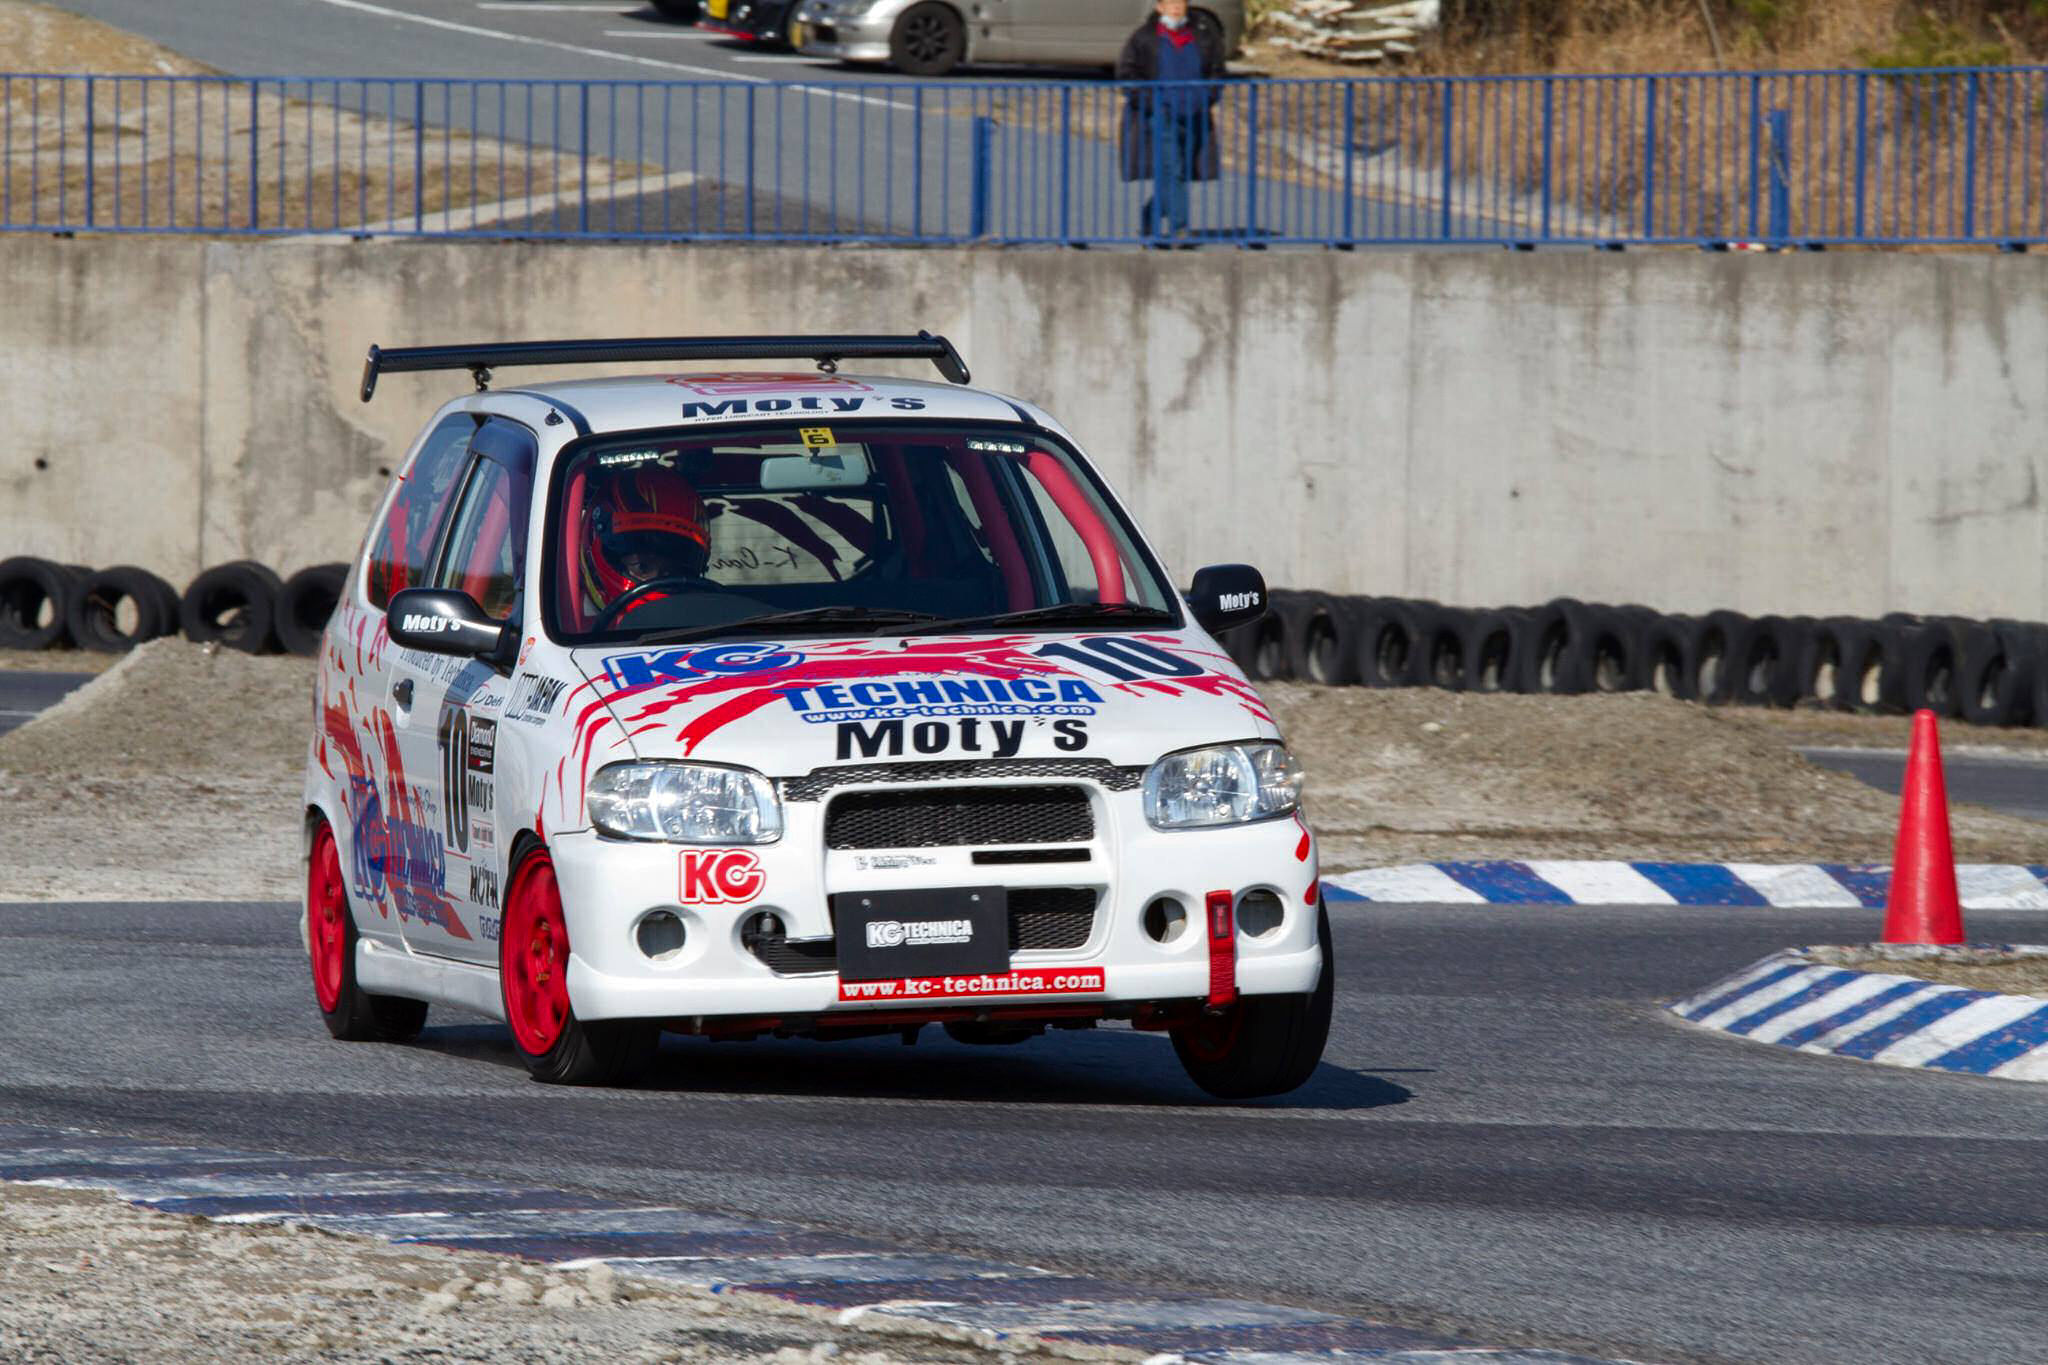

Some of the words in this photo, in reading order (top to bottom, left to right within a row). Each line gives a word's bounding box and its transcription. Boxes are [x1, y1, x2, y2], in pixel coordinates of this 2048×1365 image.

[682, 396, 926, 418] Moty's
[1219, 591, 1260, 610] Moty's
[402, 614, 461, 632] Moty's
[606, 643, 803, 690] KC
[1031, 636, 1205, 682] 10
[773, 678, 1106, 712] TECHNICA
[804, 704, 1095, 723] www.kc-technica.com
[836, 716, 1089, 760] Moty's
[438, 708, 469, 853] 10
[468, 774, 494, 812] Moty's
[680, 850, 765, 903] KC
[866, 921, 905, 948] KC
[902, 920, 973, 938] TECHNICA
[842, 972, 1102, 998] www.kc-technica.com
